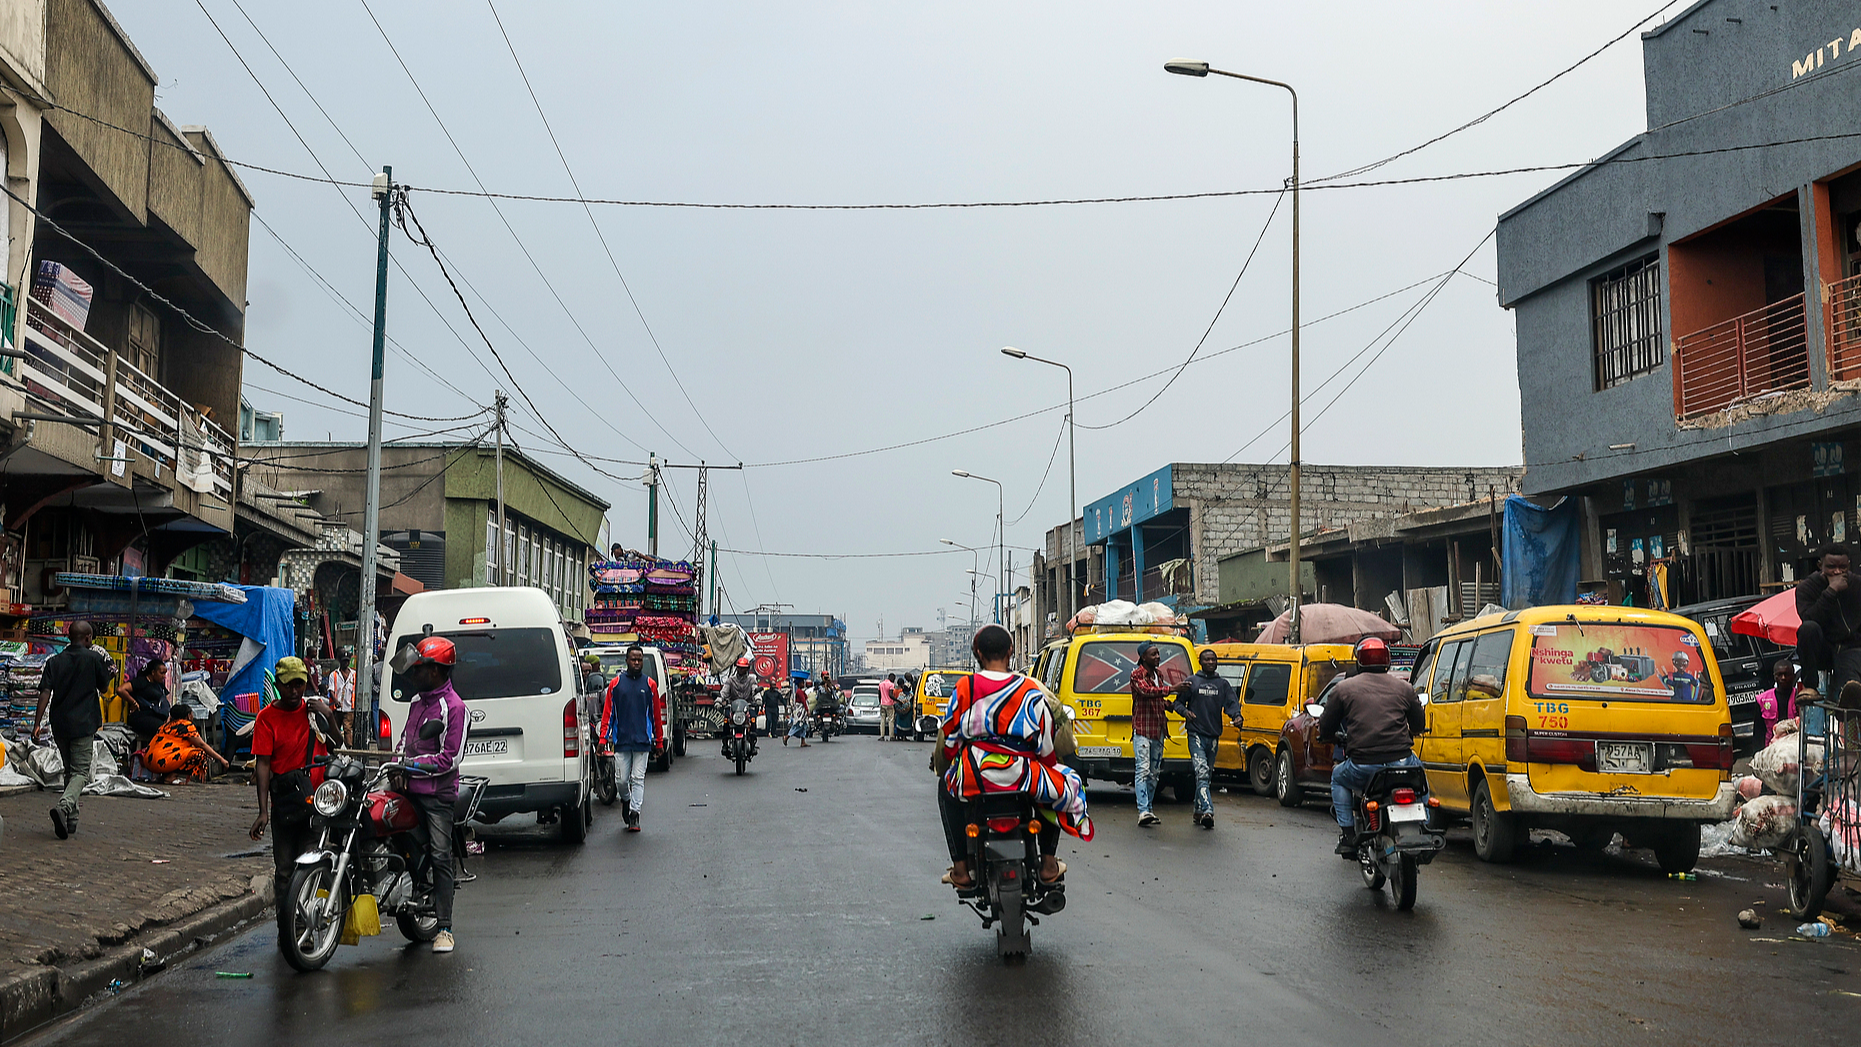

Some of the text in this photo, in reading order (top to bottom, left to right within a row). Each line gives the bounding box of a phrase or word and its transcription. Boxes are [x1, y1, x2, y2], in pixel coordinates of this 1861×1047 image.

[1792, 28, 1861, 80] MITA
[1531, 647, 1574, 658] Nshinga
[1540, 656, 1573, 665] kwetu
[1734, 682, 1757, 690] PRADO
[1079, 700, 1102, 708] TBG
[1534, 702, 1569, 714] TBG
[1082, 708, 1101, 717] 367
[1538, 715, 1568, 729] 750
[494, 741, 506, 752] 22
